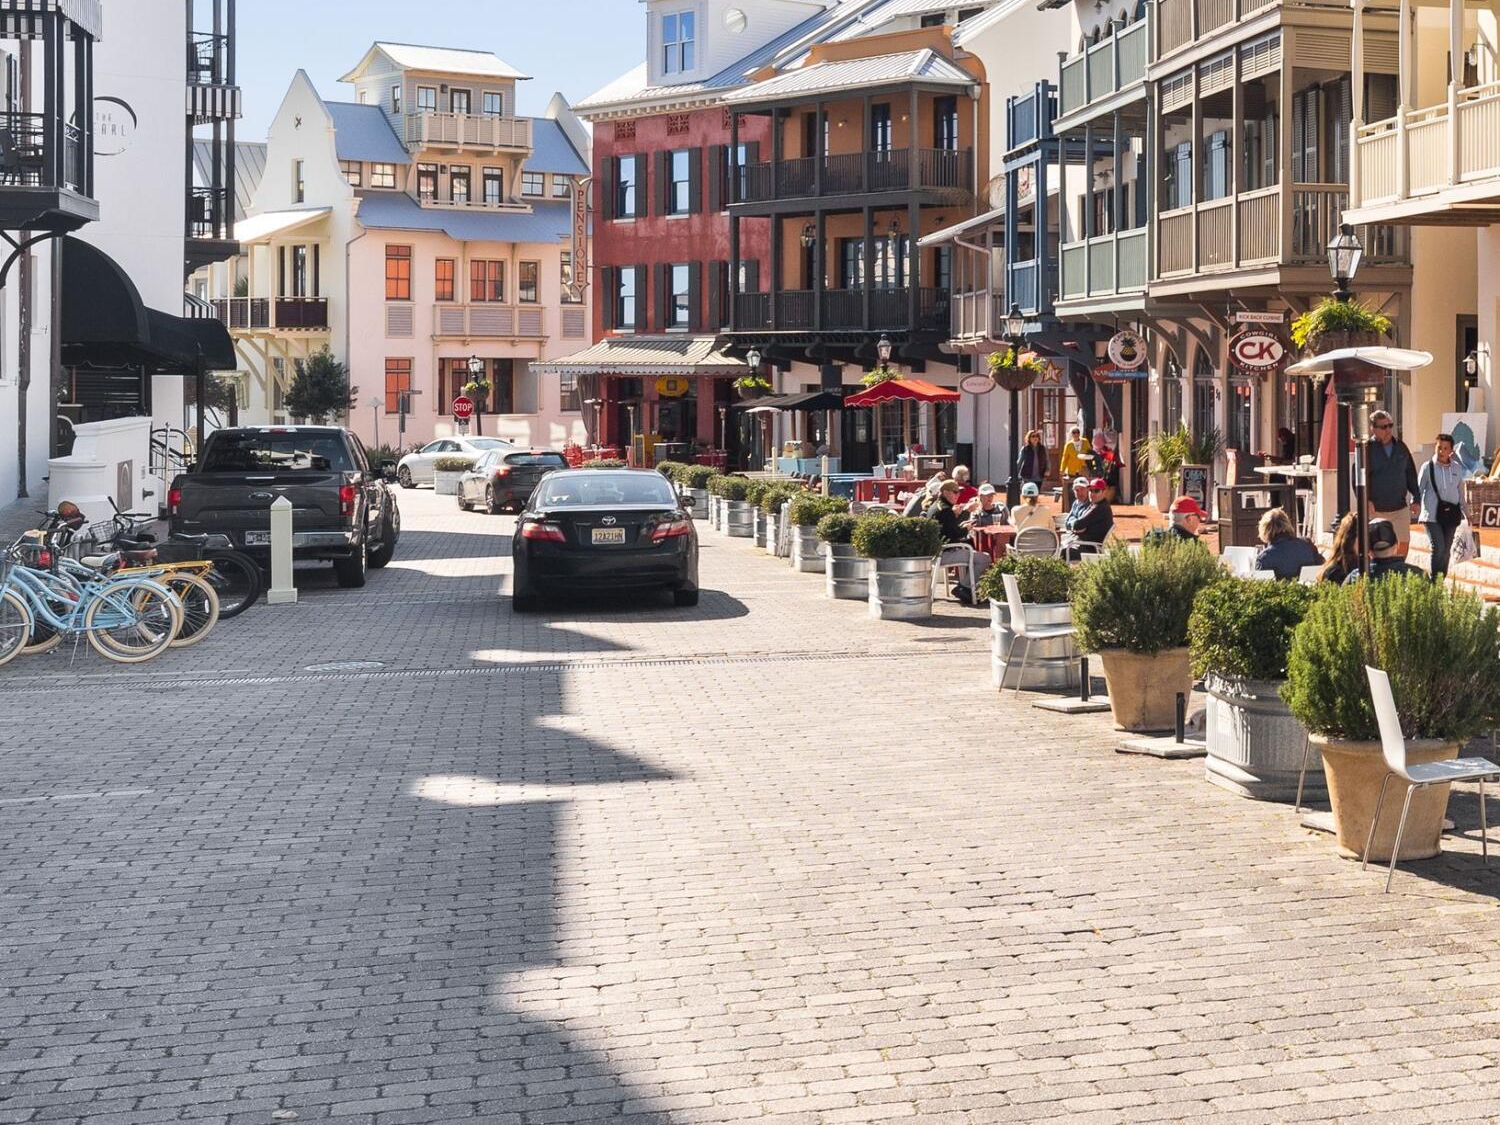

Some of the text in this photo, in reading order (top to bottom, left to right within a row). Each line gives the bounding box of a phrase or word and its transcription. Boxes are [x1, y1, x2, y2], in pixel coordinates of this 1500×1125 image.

[575, 189, 586, 283] PENSIONE
[1240, 330, 1279, 341] COWGIRL
[1238, 341, 1276, 360] CK
[1240, 362, 1279, 371] KITCHEN
[454, 403, 472, 412] STOP
